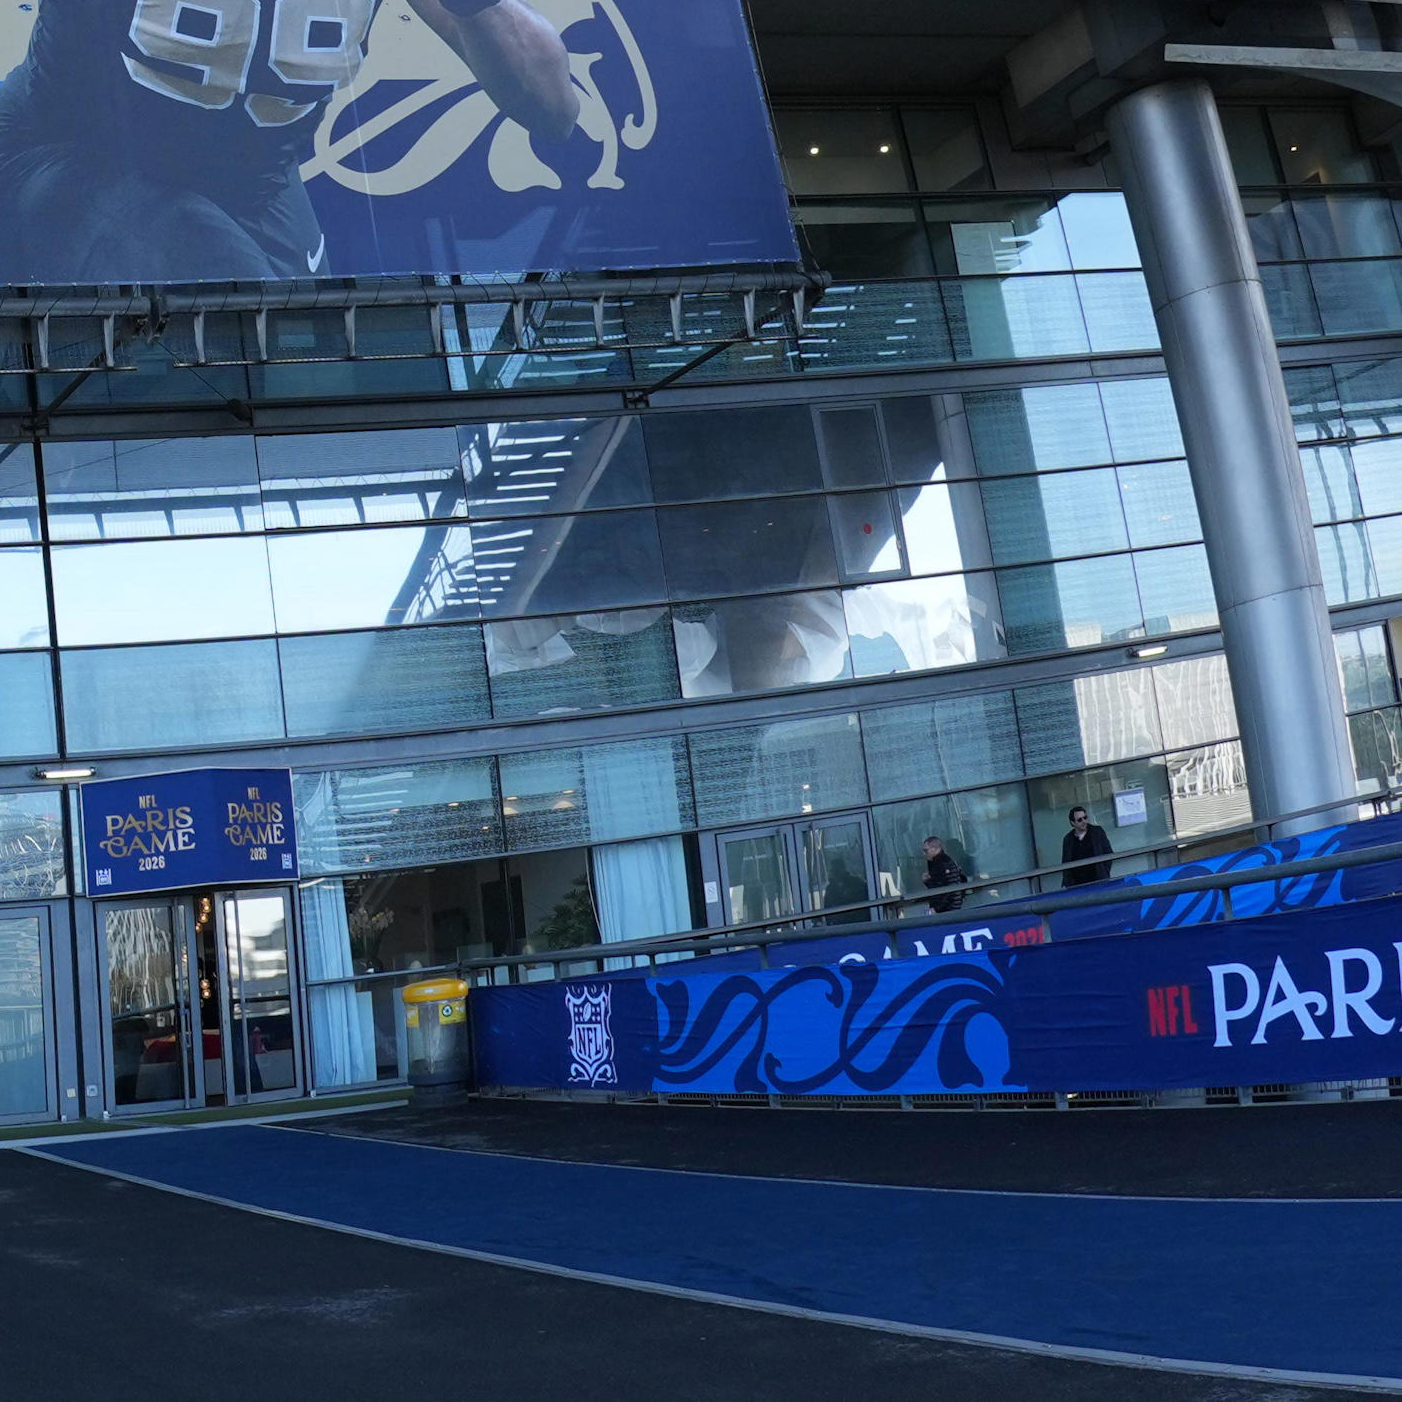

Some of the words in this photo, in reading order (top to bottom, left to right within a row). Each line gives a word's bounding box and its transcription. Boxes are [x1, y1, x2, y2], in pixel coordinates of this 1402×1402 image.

[139, 795, 157, 809] NFL
[247, 787, 260, 800] NFL
[105, 806, 194, 837] PARIS
[227, 802, 283, 824] PARIS
[100, 828, 196, 858] GAME
[224, 823, 285, 846] GAME
[138, 856, 165, 871] 2026
[250, 847, 268, 861] 2026
[1148, 985, 1198, 1037] NFL
[577, 1026, 601, 1058] NFL
